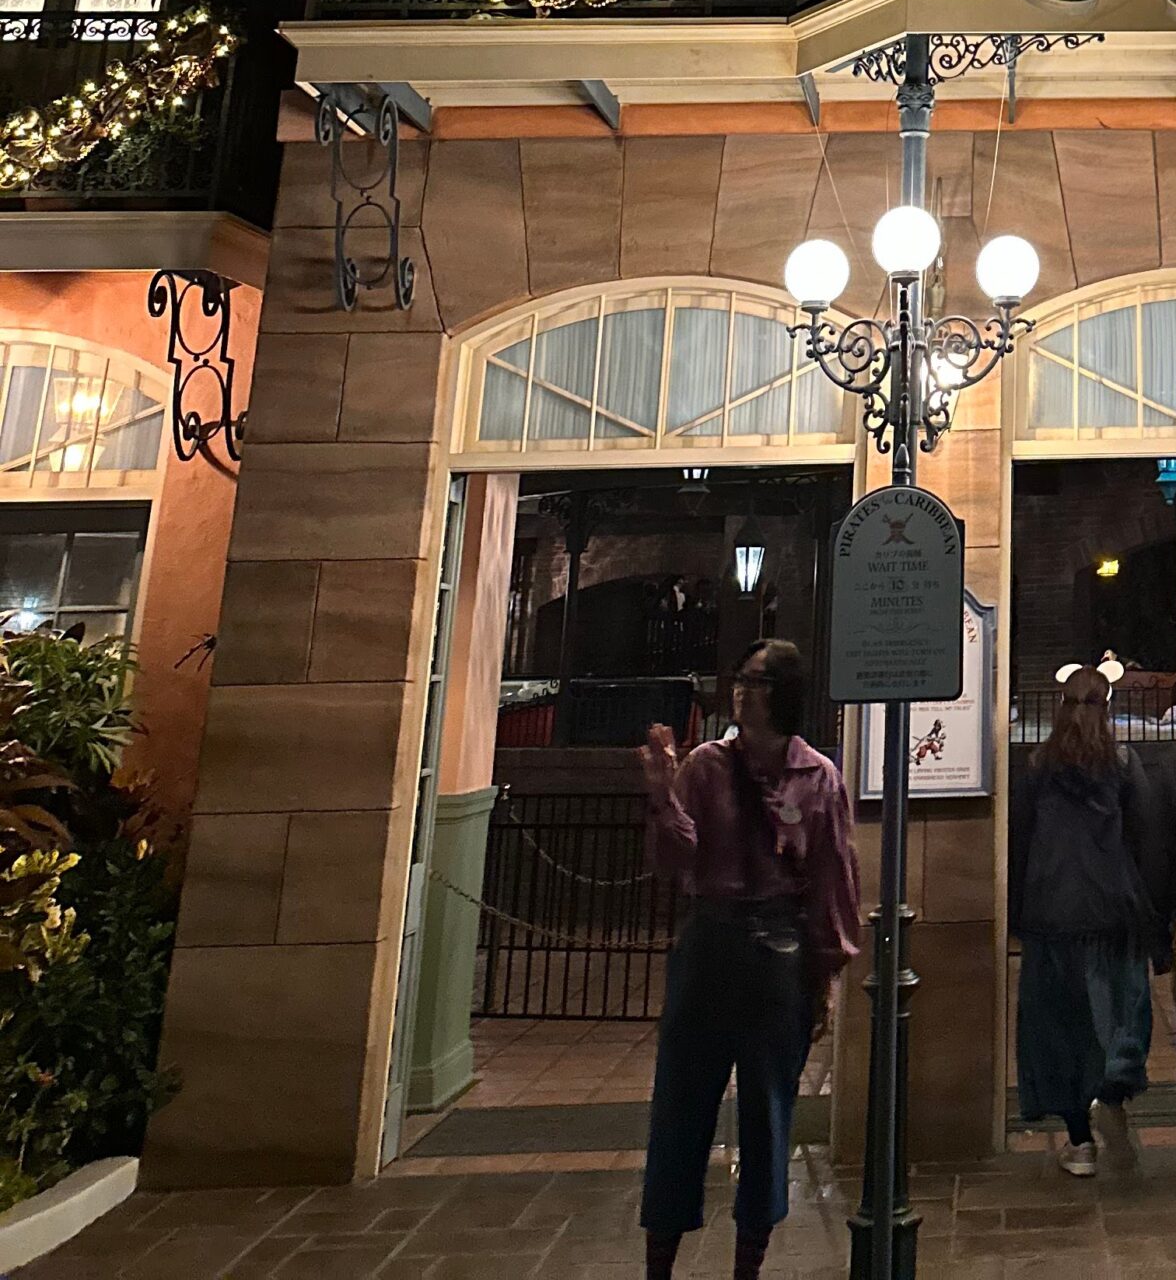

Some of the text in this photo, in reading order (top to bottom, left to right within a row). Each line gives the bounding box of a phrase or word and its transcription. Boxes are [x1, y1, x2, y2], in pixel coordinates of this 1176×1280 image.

[839, 499, 881, 557] PIRATES
[894, 492, 956, 556] CARIBBEAN
[867, 561, 929, 573] WAIT TIME
[871, 596, 924, 608] MINUTES
